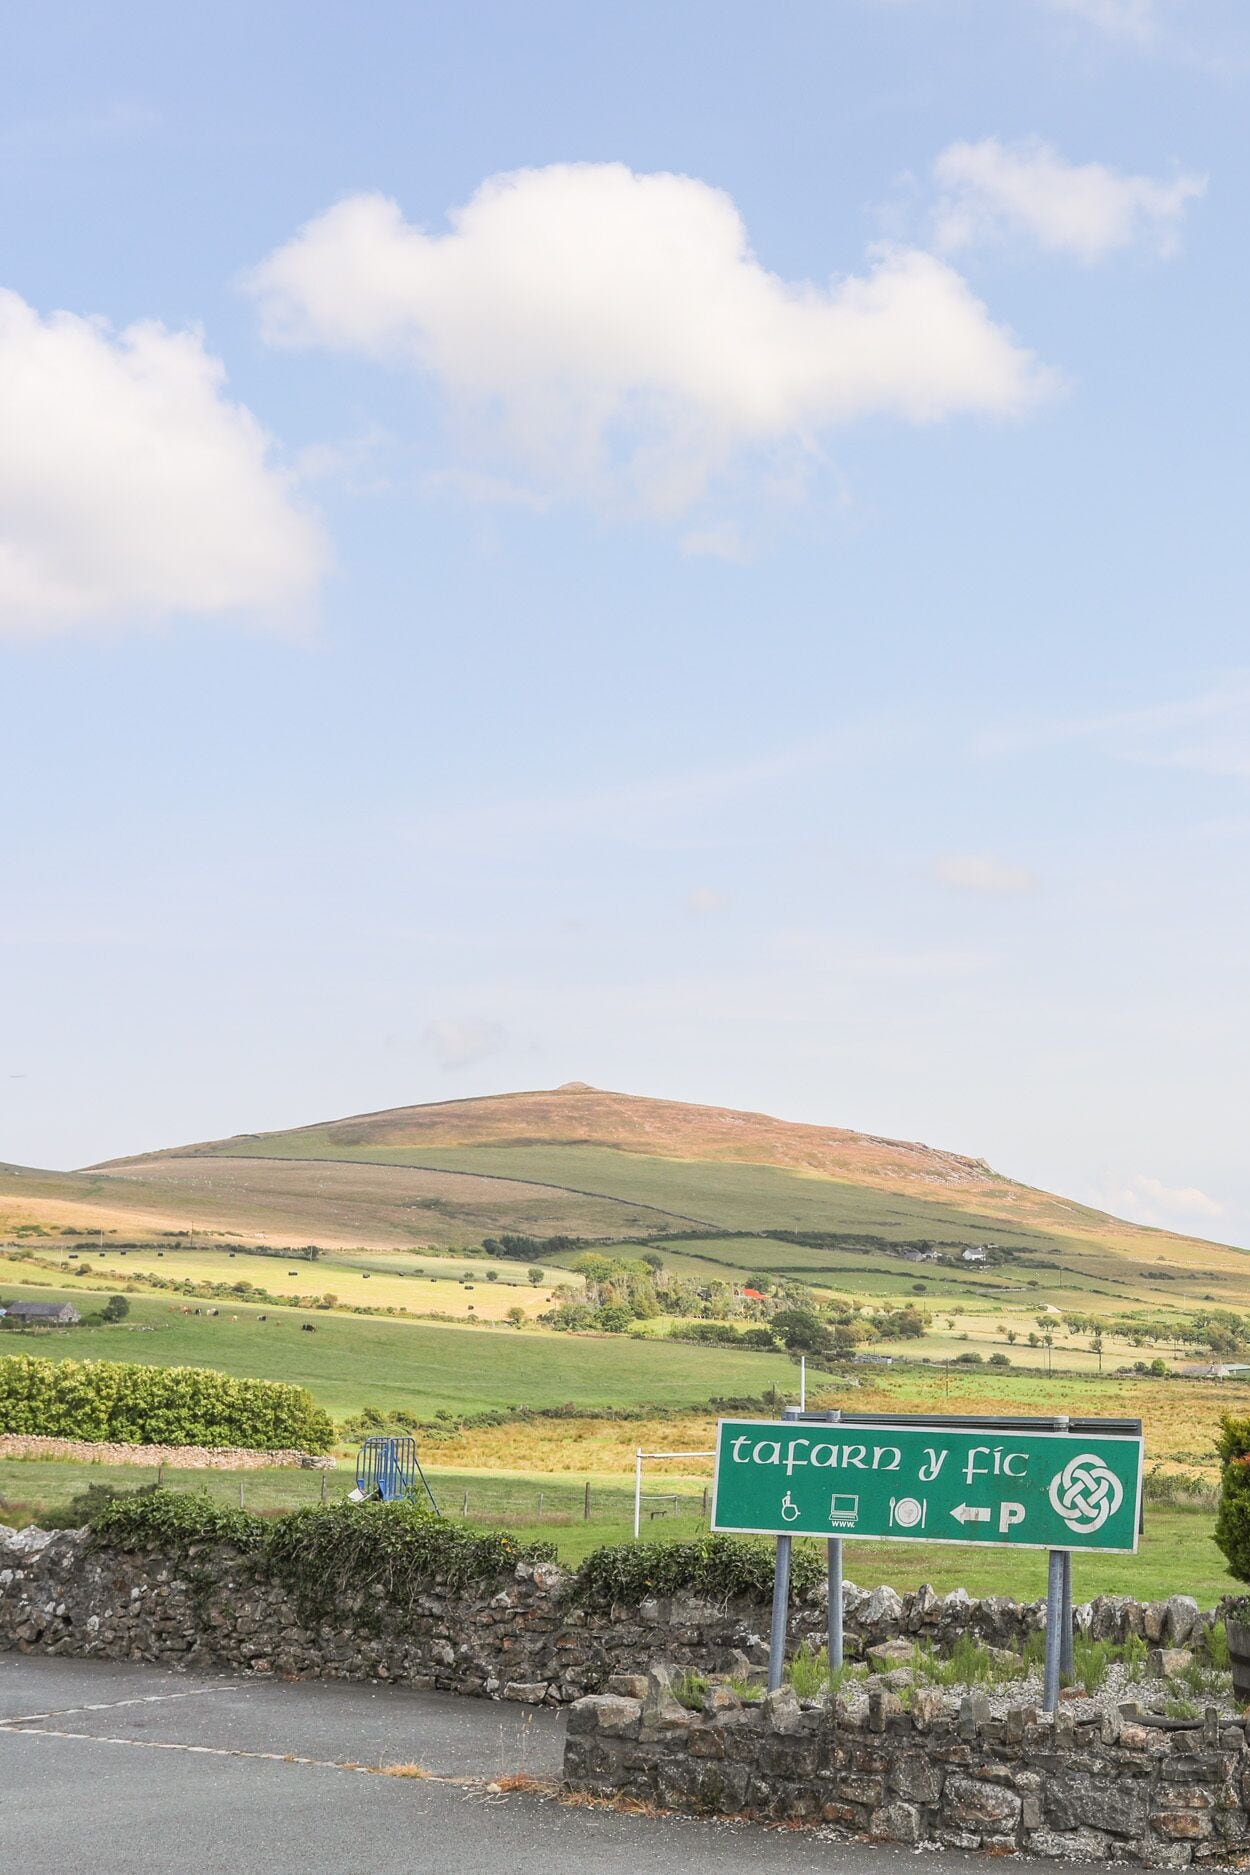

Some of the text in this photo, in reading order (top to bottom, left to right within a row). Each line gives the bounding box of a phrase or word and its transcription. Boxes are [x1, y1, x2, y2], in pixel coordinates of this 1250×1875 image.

[730, 1436, 902, 1475] tafarn
[918, 1448, 949, 1482] y
[999, 1502, 1026, 1533] P
